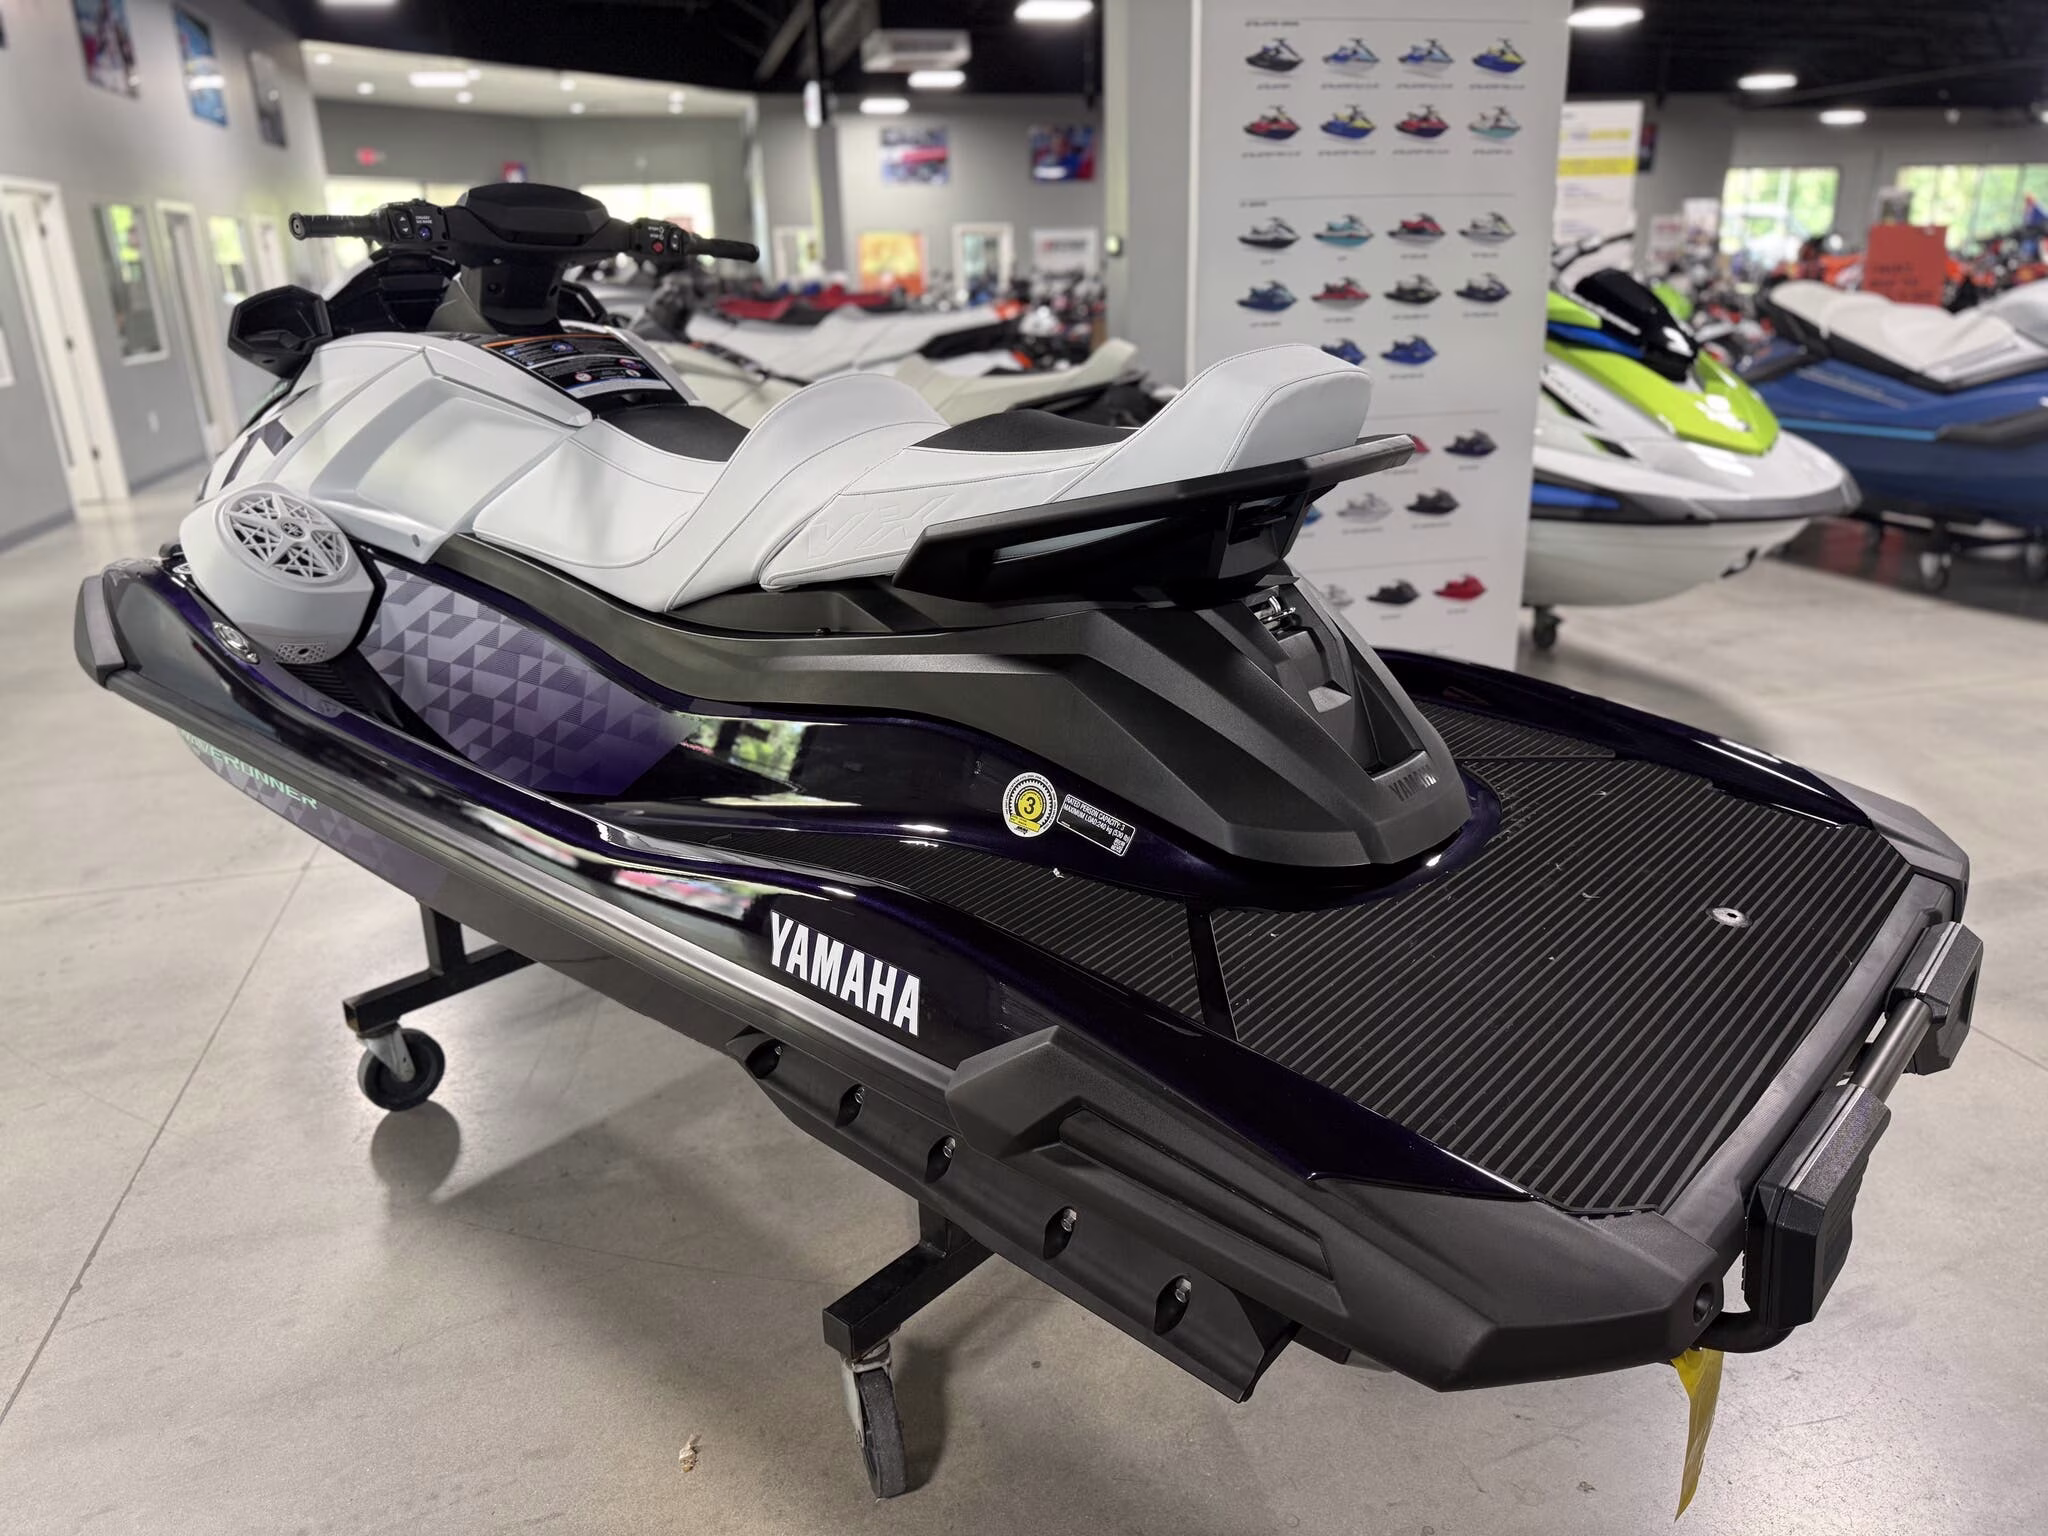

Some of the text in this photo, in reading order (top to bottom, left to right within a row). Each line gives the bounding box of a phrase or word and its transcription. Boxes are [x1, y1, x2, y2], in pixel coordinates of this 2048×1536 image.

[1023, 796, 1036, 814] 3
[1063, 803, 1086, 819] MAXIMUM
[1105, 826, 1113, 835] kg
[1080, 803, 1099, 817] PERSON
[1121, 824, 1126, 832] 3
[771, 911, 920, 1036] YAMAHA
